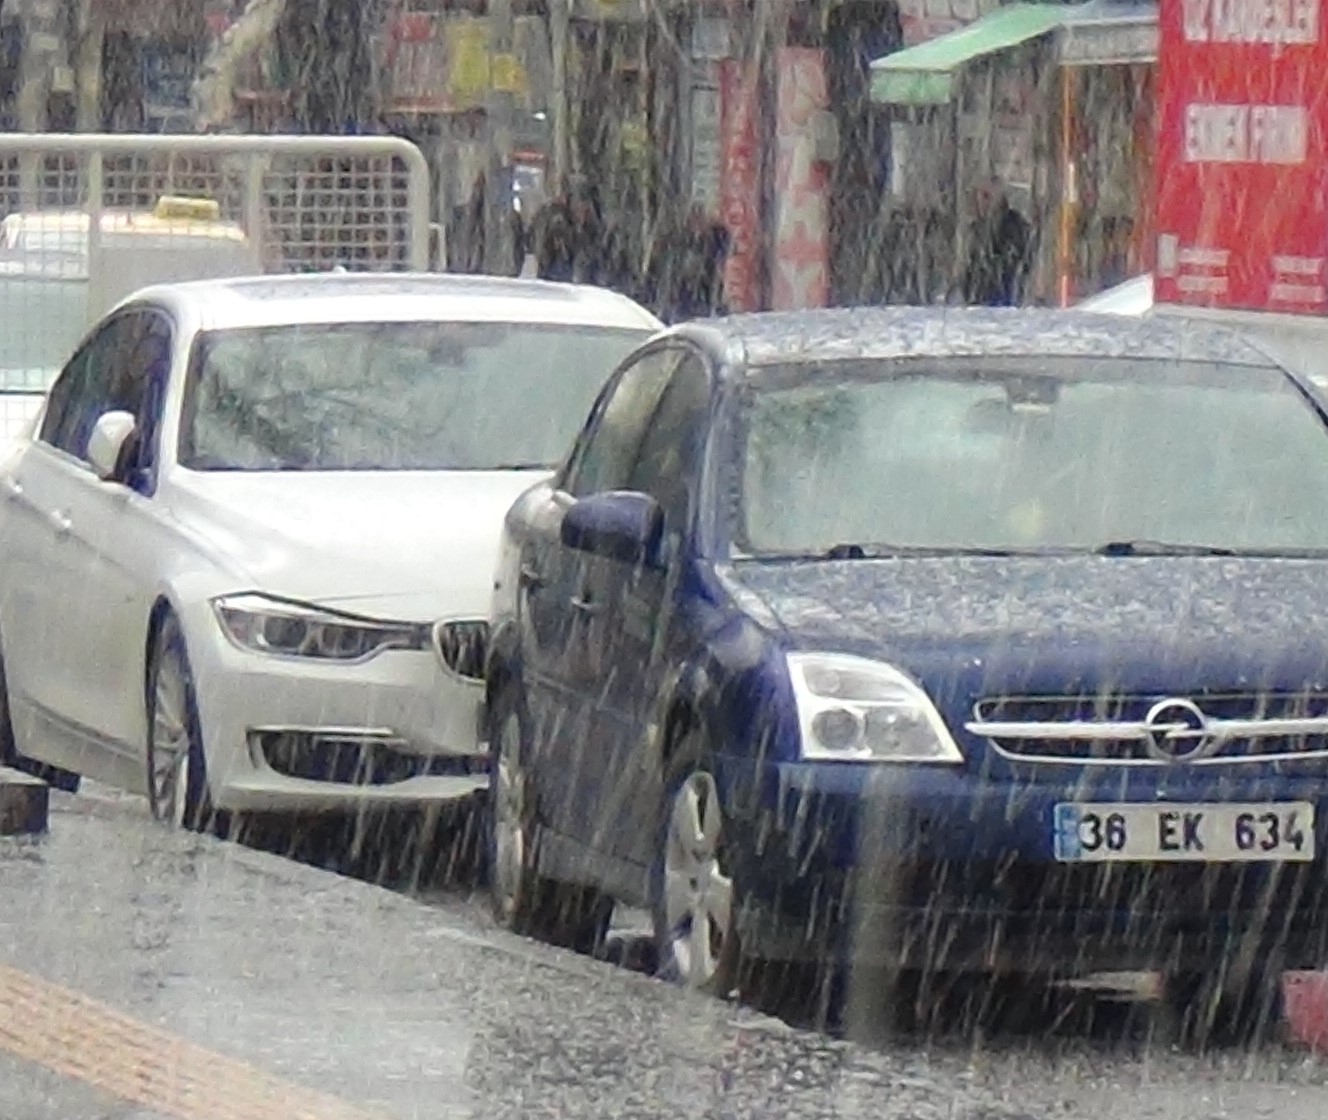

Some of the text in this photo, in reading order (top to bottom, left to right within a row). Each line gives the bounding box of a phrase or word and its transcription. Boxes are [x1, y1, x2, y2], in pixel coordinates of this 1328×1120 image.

[1080, 812, 1127, 851] 36
[1159, 811, 1205, 851] EK
[1235, 812, 1304, 851] 634
